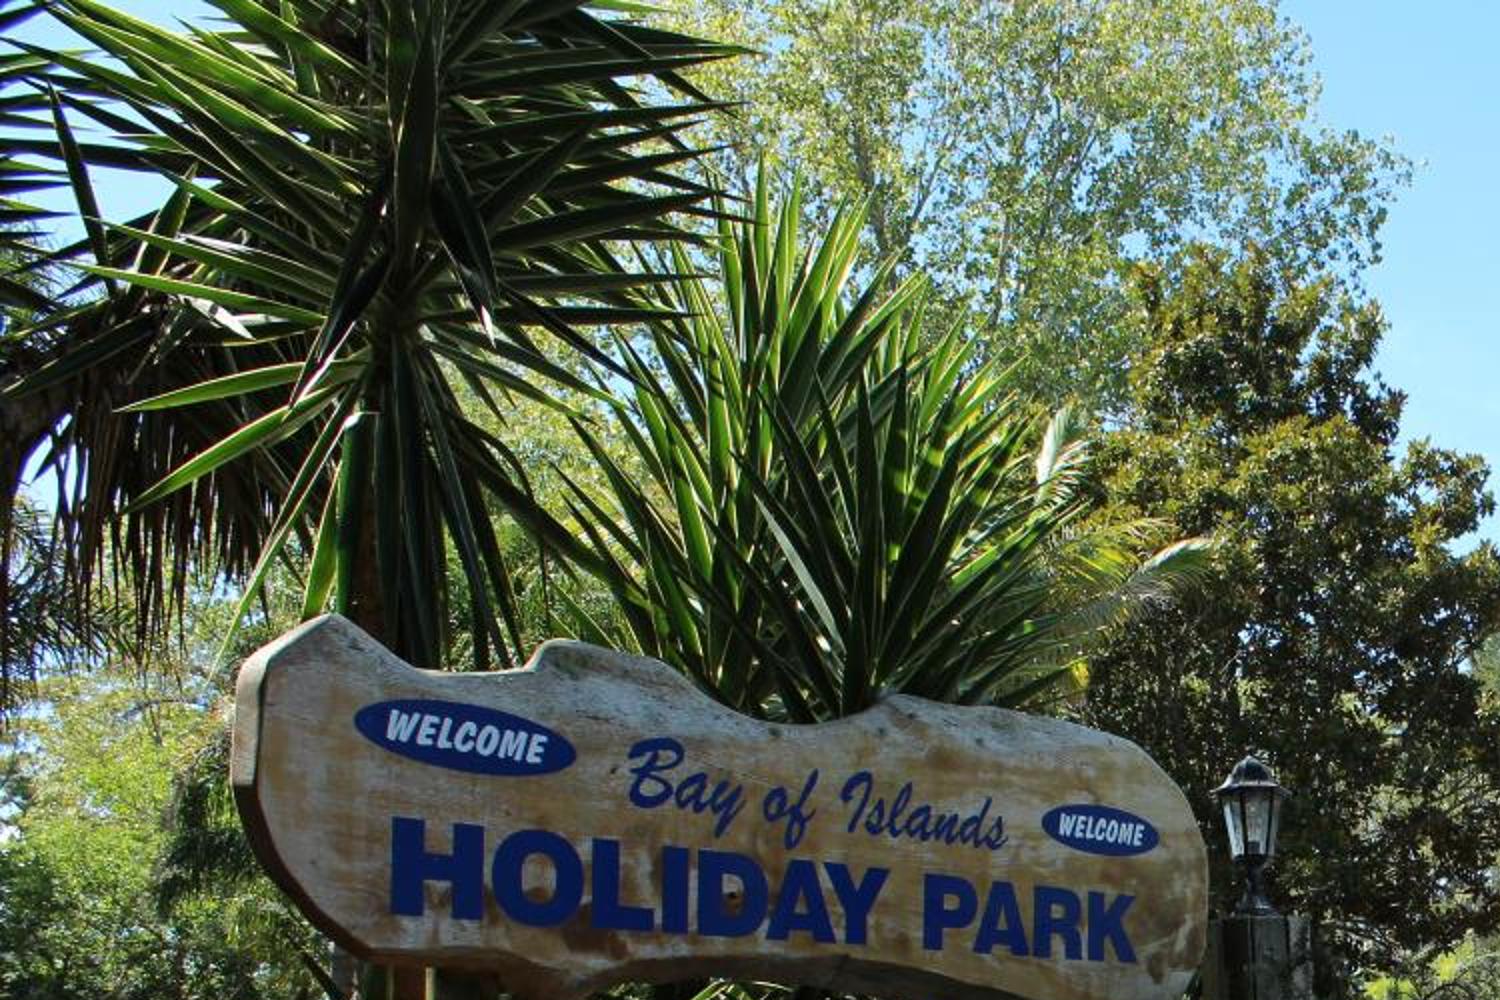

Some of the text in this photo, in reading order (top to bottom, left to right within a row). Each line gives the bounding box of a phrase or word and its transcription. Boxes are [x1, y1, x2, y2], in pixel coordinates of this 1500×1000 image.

[386, 709, 549, 764] WELCOME
[627, 737, 1010, 851] Bay of Islands
[1058, 813, 1145, 847] WELCOME
[389, 816, 1138, 964] HOLIDAY PARK
